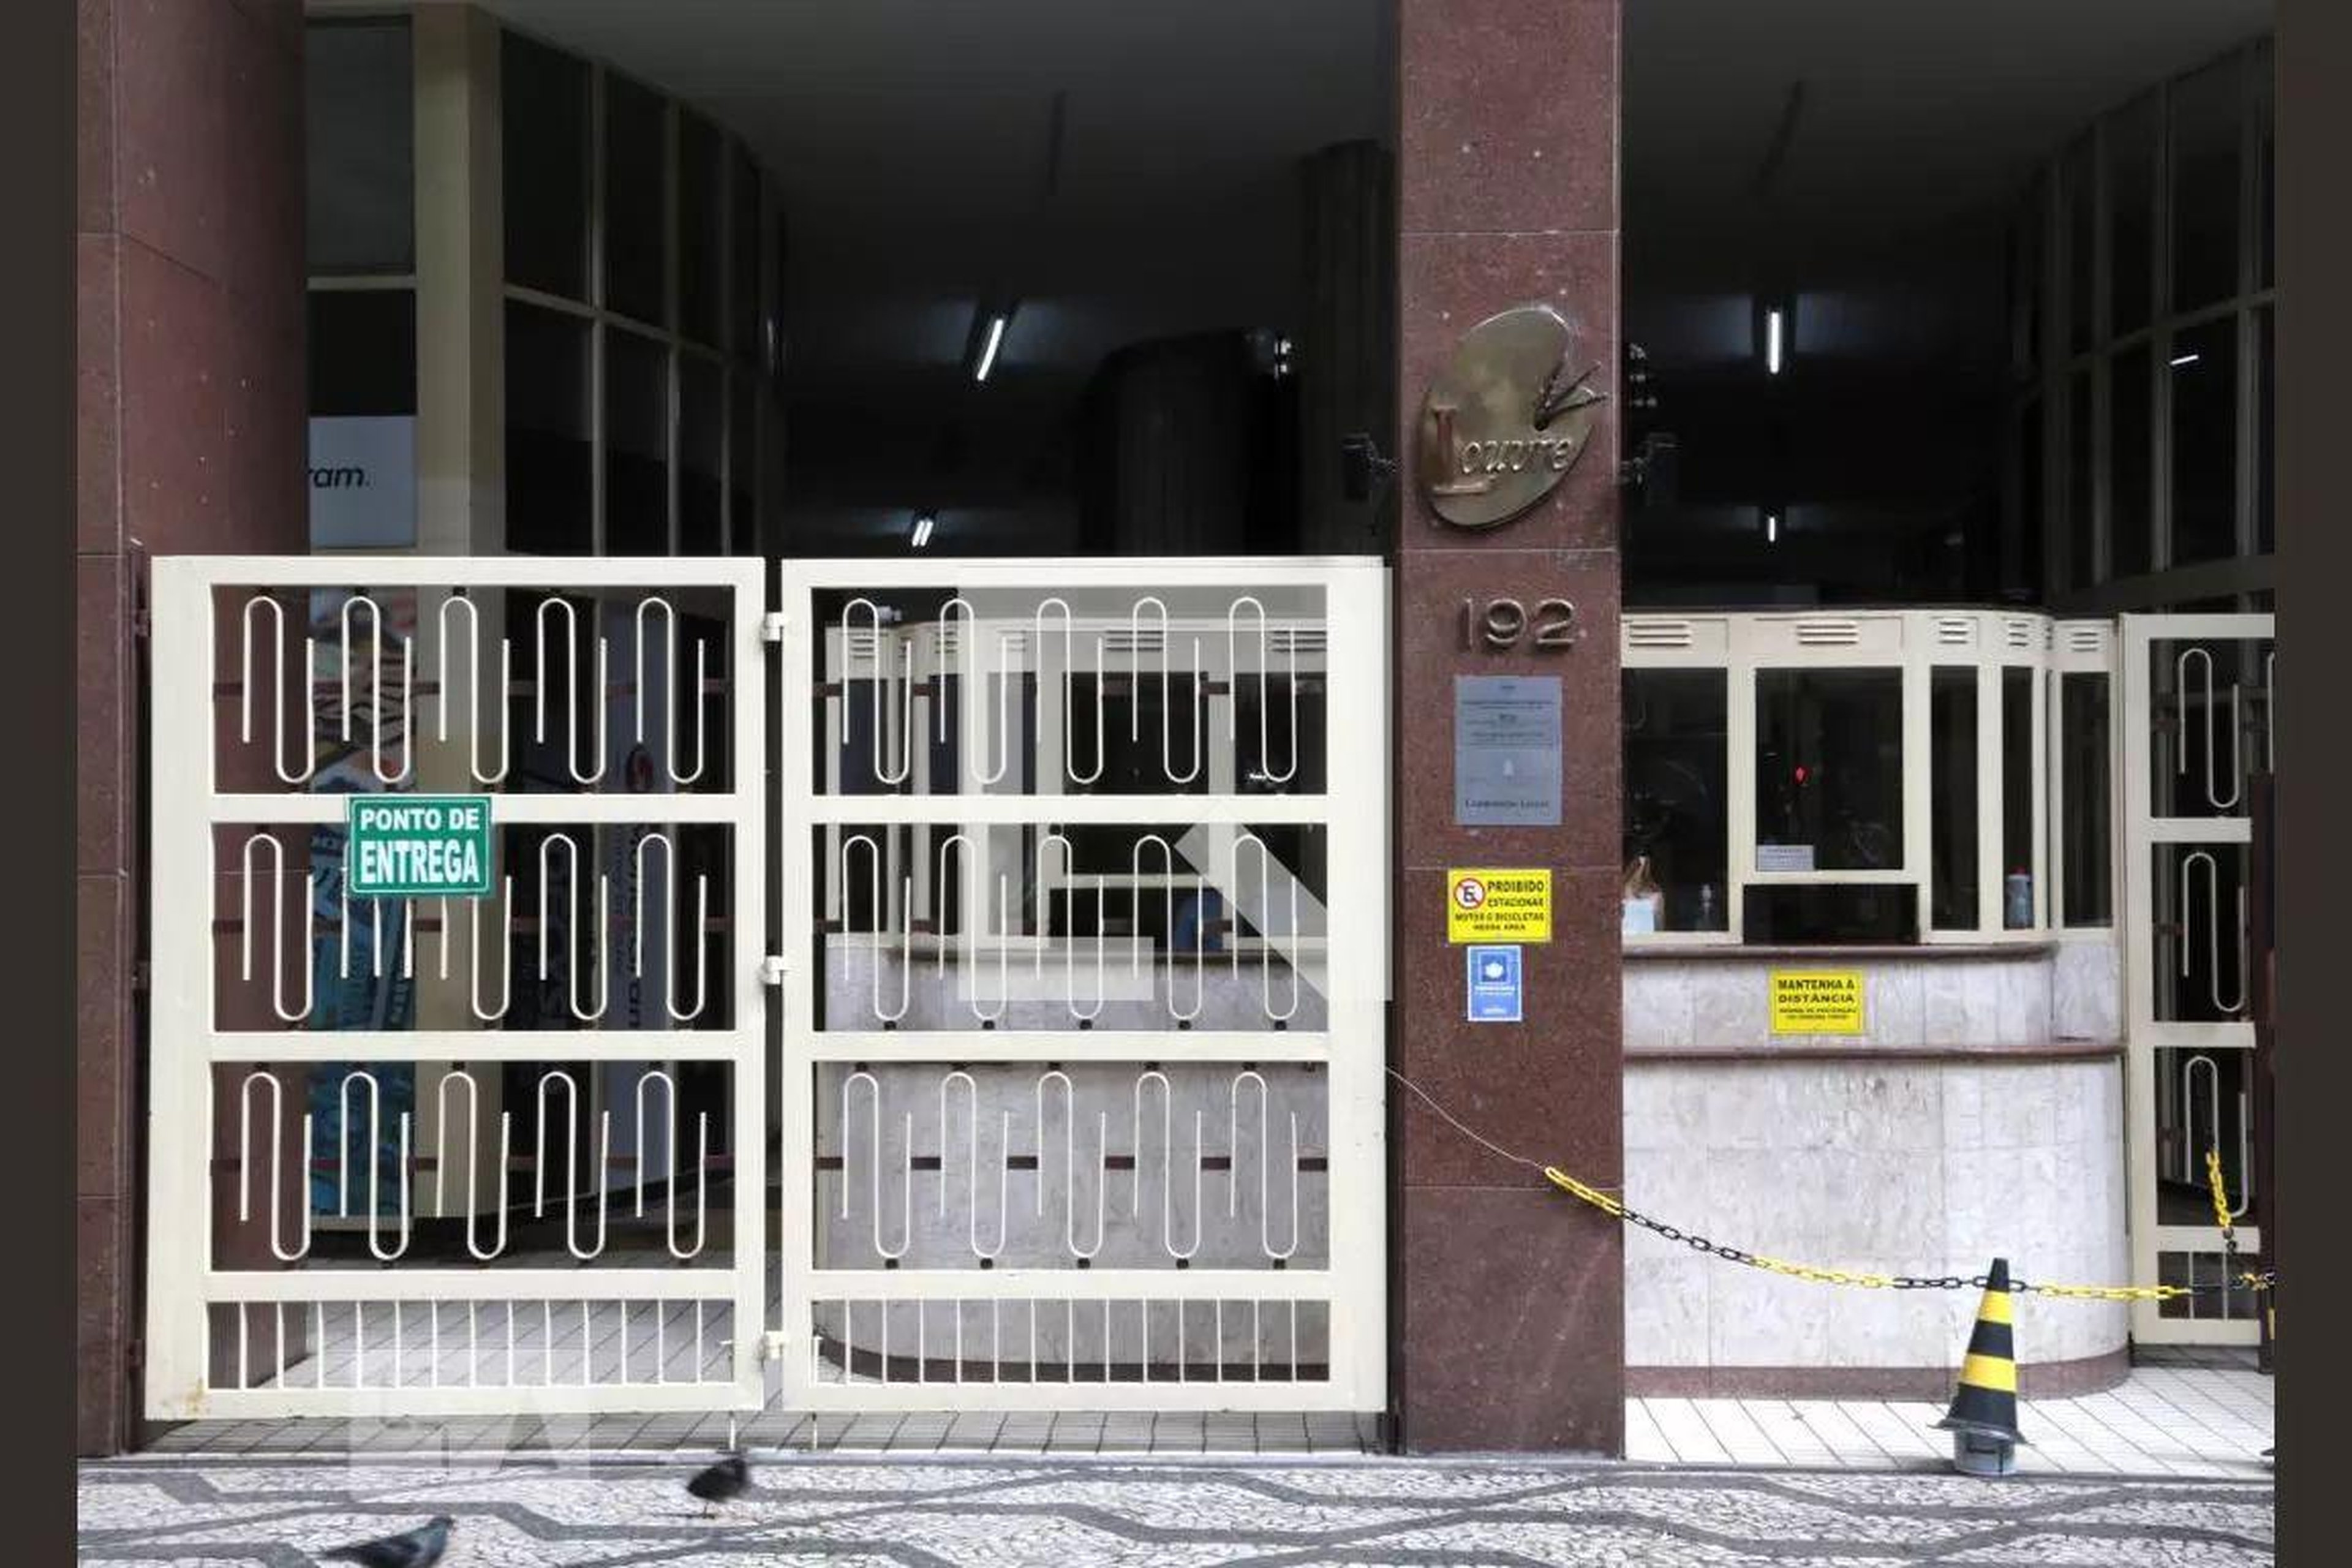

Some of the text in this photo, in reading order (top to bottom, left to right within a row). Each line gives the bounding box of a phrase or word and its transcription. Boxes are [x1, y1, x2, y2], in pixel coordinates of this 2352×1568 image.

[1428, 403, 1571, 495] Louvre
[1460, 598, 1576, 649] 192
[360, 807, 480, 831] PONTO DE
[360, 838, 480, 884] ENTREGA
[1488, 881, 1544, 892] PROIBIDO
[1488, 898, 1544, 907] ESTACIONAR
[1777, 979, 1843, 990] MANTENHA
